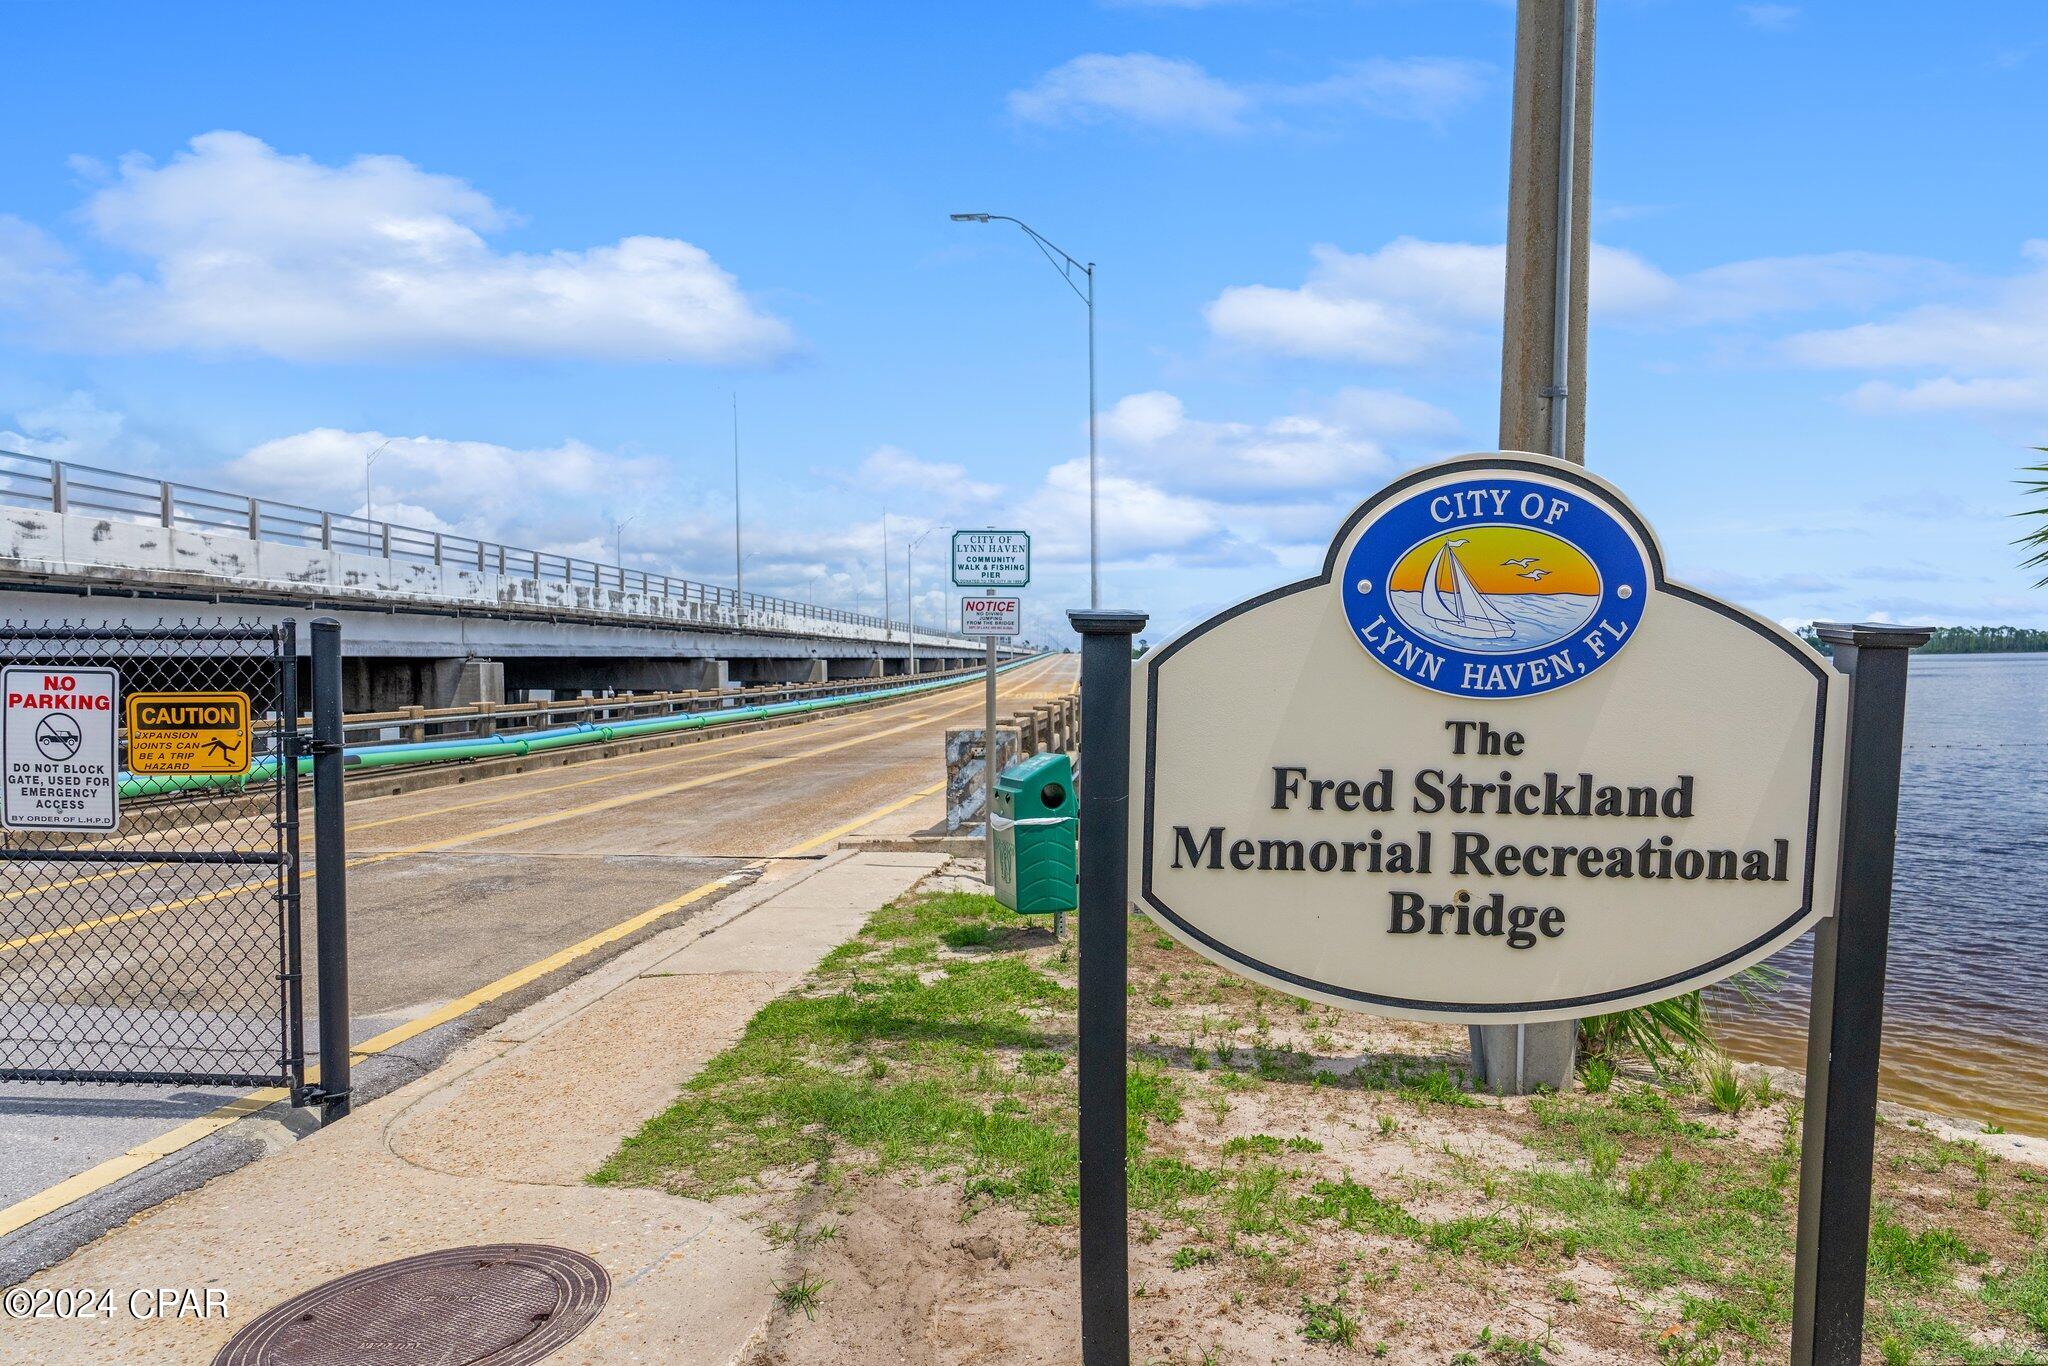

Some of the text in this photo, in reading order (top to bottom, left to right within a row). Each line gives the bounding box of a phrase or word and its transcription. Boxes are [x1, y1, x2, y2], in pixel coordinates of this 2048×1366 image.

[1429, 489, 1570, 525] CITY OF
[970, 536, 1012, 544] CITY OF
[957, 545, 1025, 553] LYNN HAVEN
[965, 601, 1016, 612] NOTICE
[1360, 614, 1629, 691] LYNN HAVEN, FL
[44, 675, 76, 691] NO
[8, 693, 110, 711] PARKING
[141, 707, 235, 725] CAUTION
[1444, 719, 1526, 757] The
[133, 742, 200, 750] JOINTS CAN
[139, 752, 195, 760] BE A TRIP
[13, 763, 104, 774] DO NOT BLOCK
[8, 775, 110, 787] GATE, USED FOR
[21, 787, 98, 798] EMERGENCY
[1270, 765, 1695, 819] Fred Strickland
[36, 799, 85, 810] ACCESS
[1170, 824, 1790, 882] Memorial Recreational
[1386, 889, 1567, 950] Bridge
